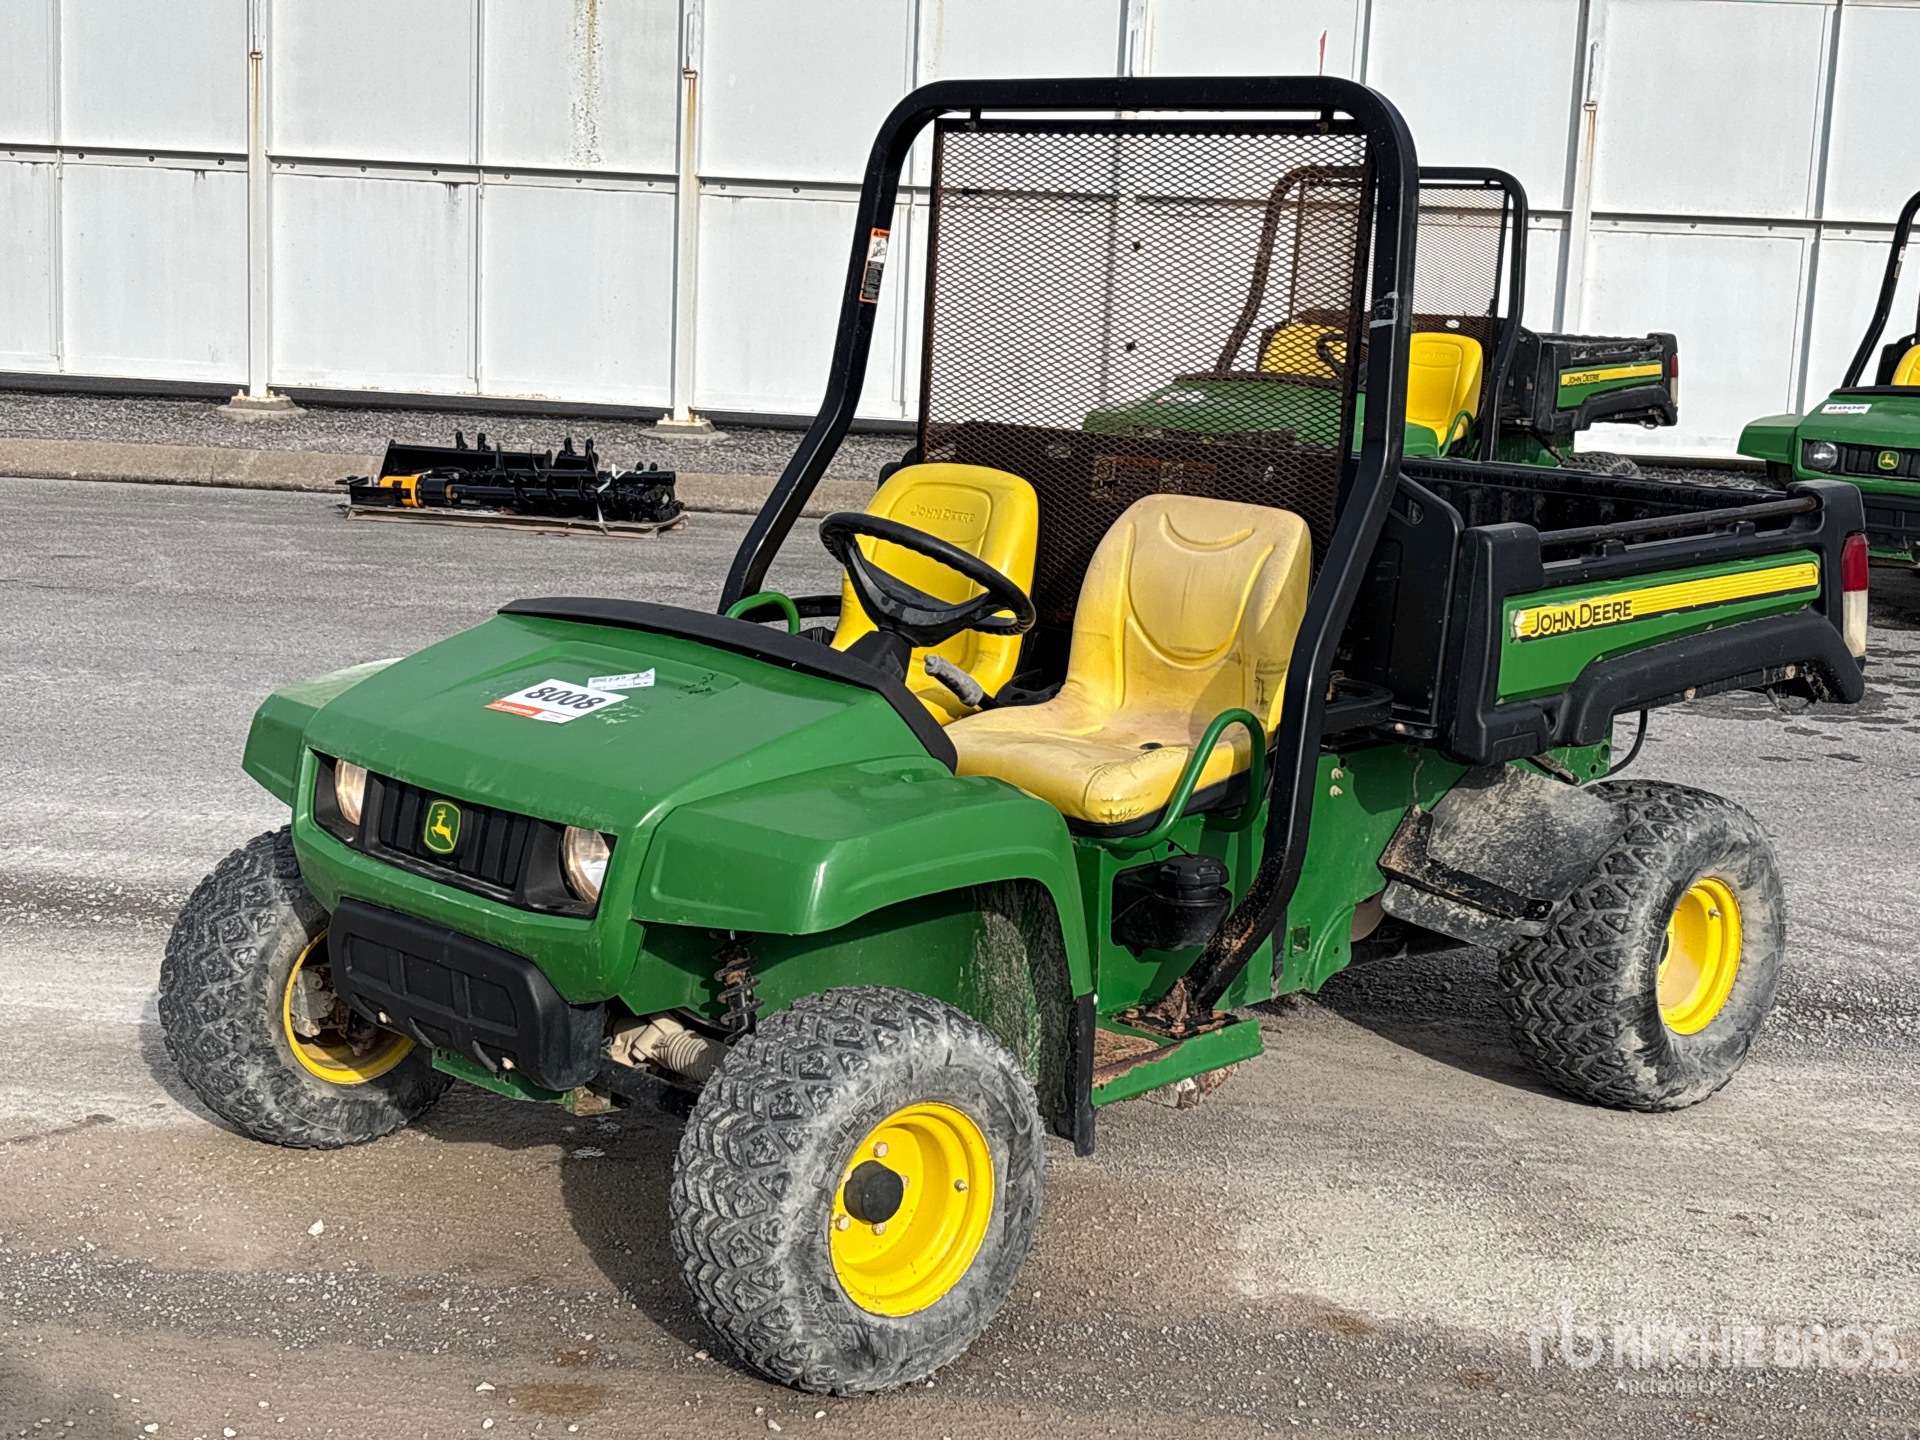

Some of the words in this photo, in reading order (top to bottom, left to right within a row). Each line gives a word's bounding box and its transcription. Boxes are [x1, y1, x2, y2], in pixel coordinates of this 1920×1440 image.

[1567, 376, 1582, 385] JOHN
[1582, 373, 1600, 383] DEERE
[911, 504, 940, 520] JOHN
[940, 509, 976, 523] DEERE
[1530, 610, 1576, 635] JOHN
[1579, 600, 1633, 626] DEERE
[524, 687, 607, 710] 8008
